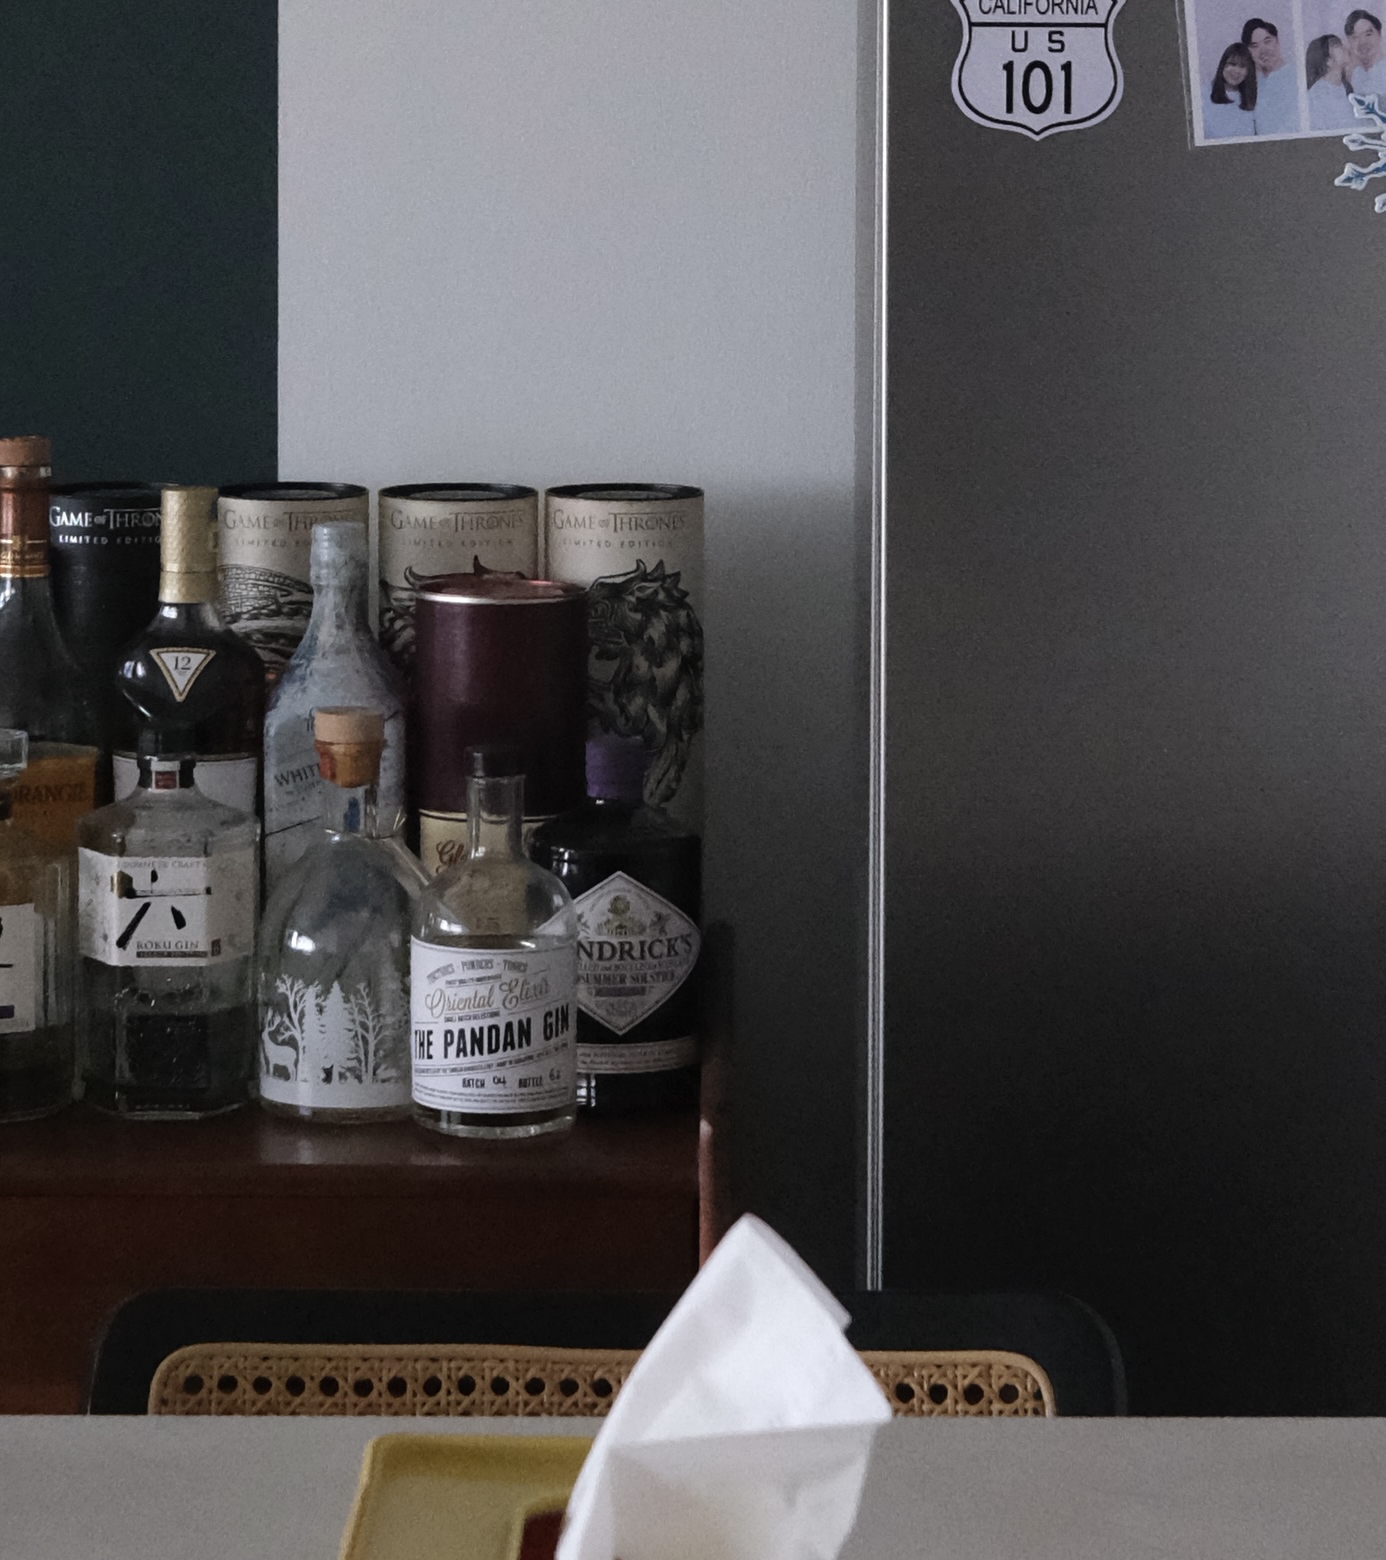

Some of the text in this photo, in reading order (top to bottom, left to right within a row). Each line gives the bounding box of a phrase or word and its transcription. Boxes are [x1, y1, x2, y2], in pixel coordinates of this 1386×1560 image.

[1002, 60, 1072, 115] 101
[48, 505, 93, 528] GAME
[224, 509, 271, 530] GAME
[390, 509, 438, 530] GAME
[449, 510, 526, 533] THRONES
[553, 508, 596, 530] GAME
[609, 510, 687, 533] THRONES
[58, 535, 162, 545] LIMITED EDITIO
[174, 655, 192, 671] 12
[274, 763, 319, 787] WHIT
[136, 940, 199, 950] ROKU GIN
[575, 934, 693, 961] NDRICK'S
[424, 977, 550, 1019] Oriental Elixir
[414, 1003, 570, 1060] THE PANDAN GIN
[462, 1076, 486, 1089] BATCH
